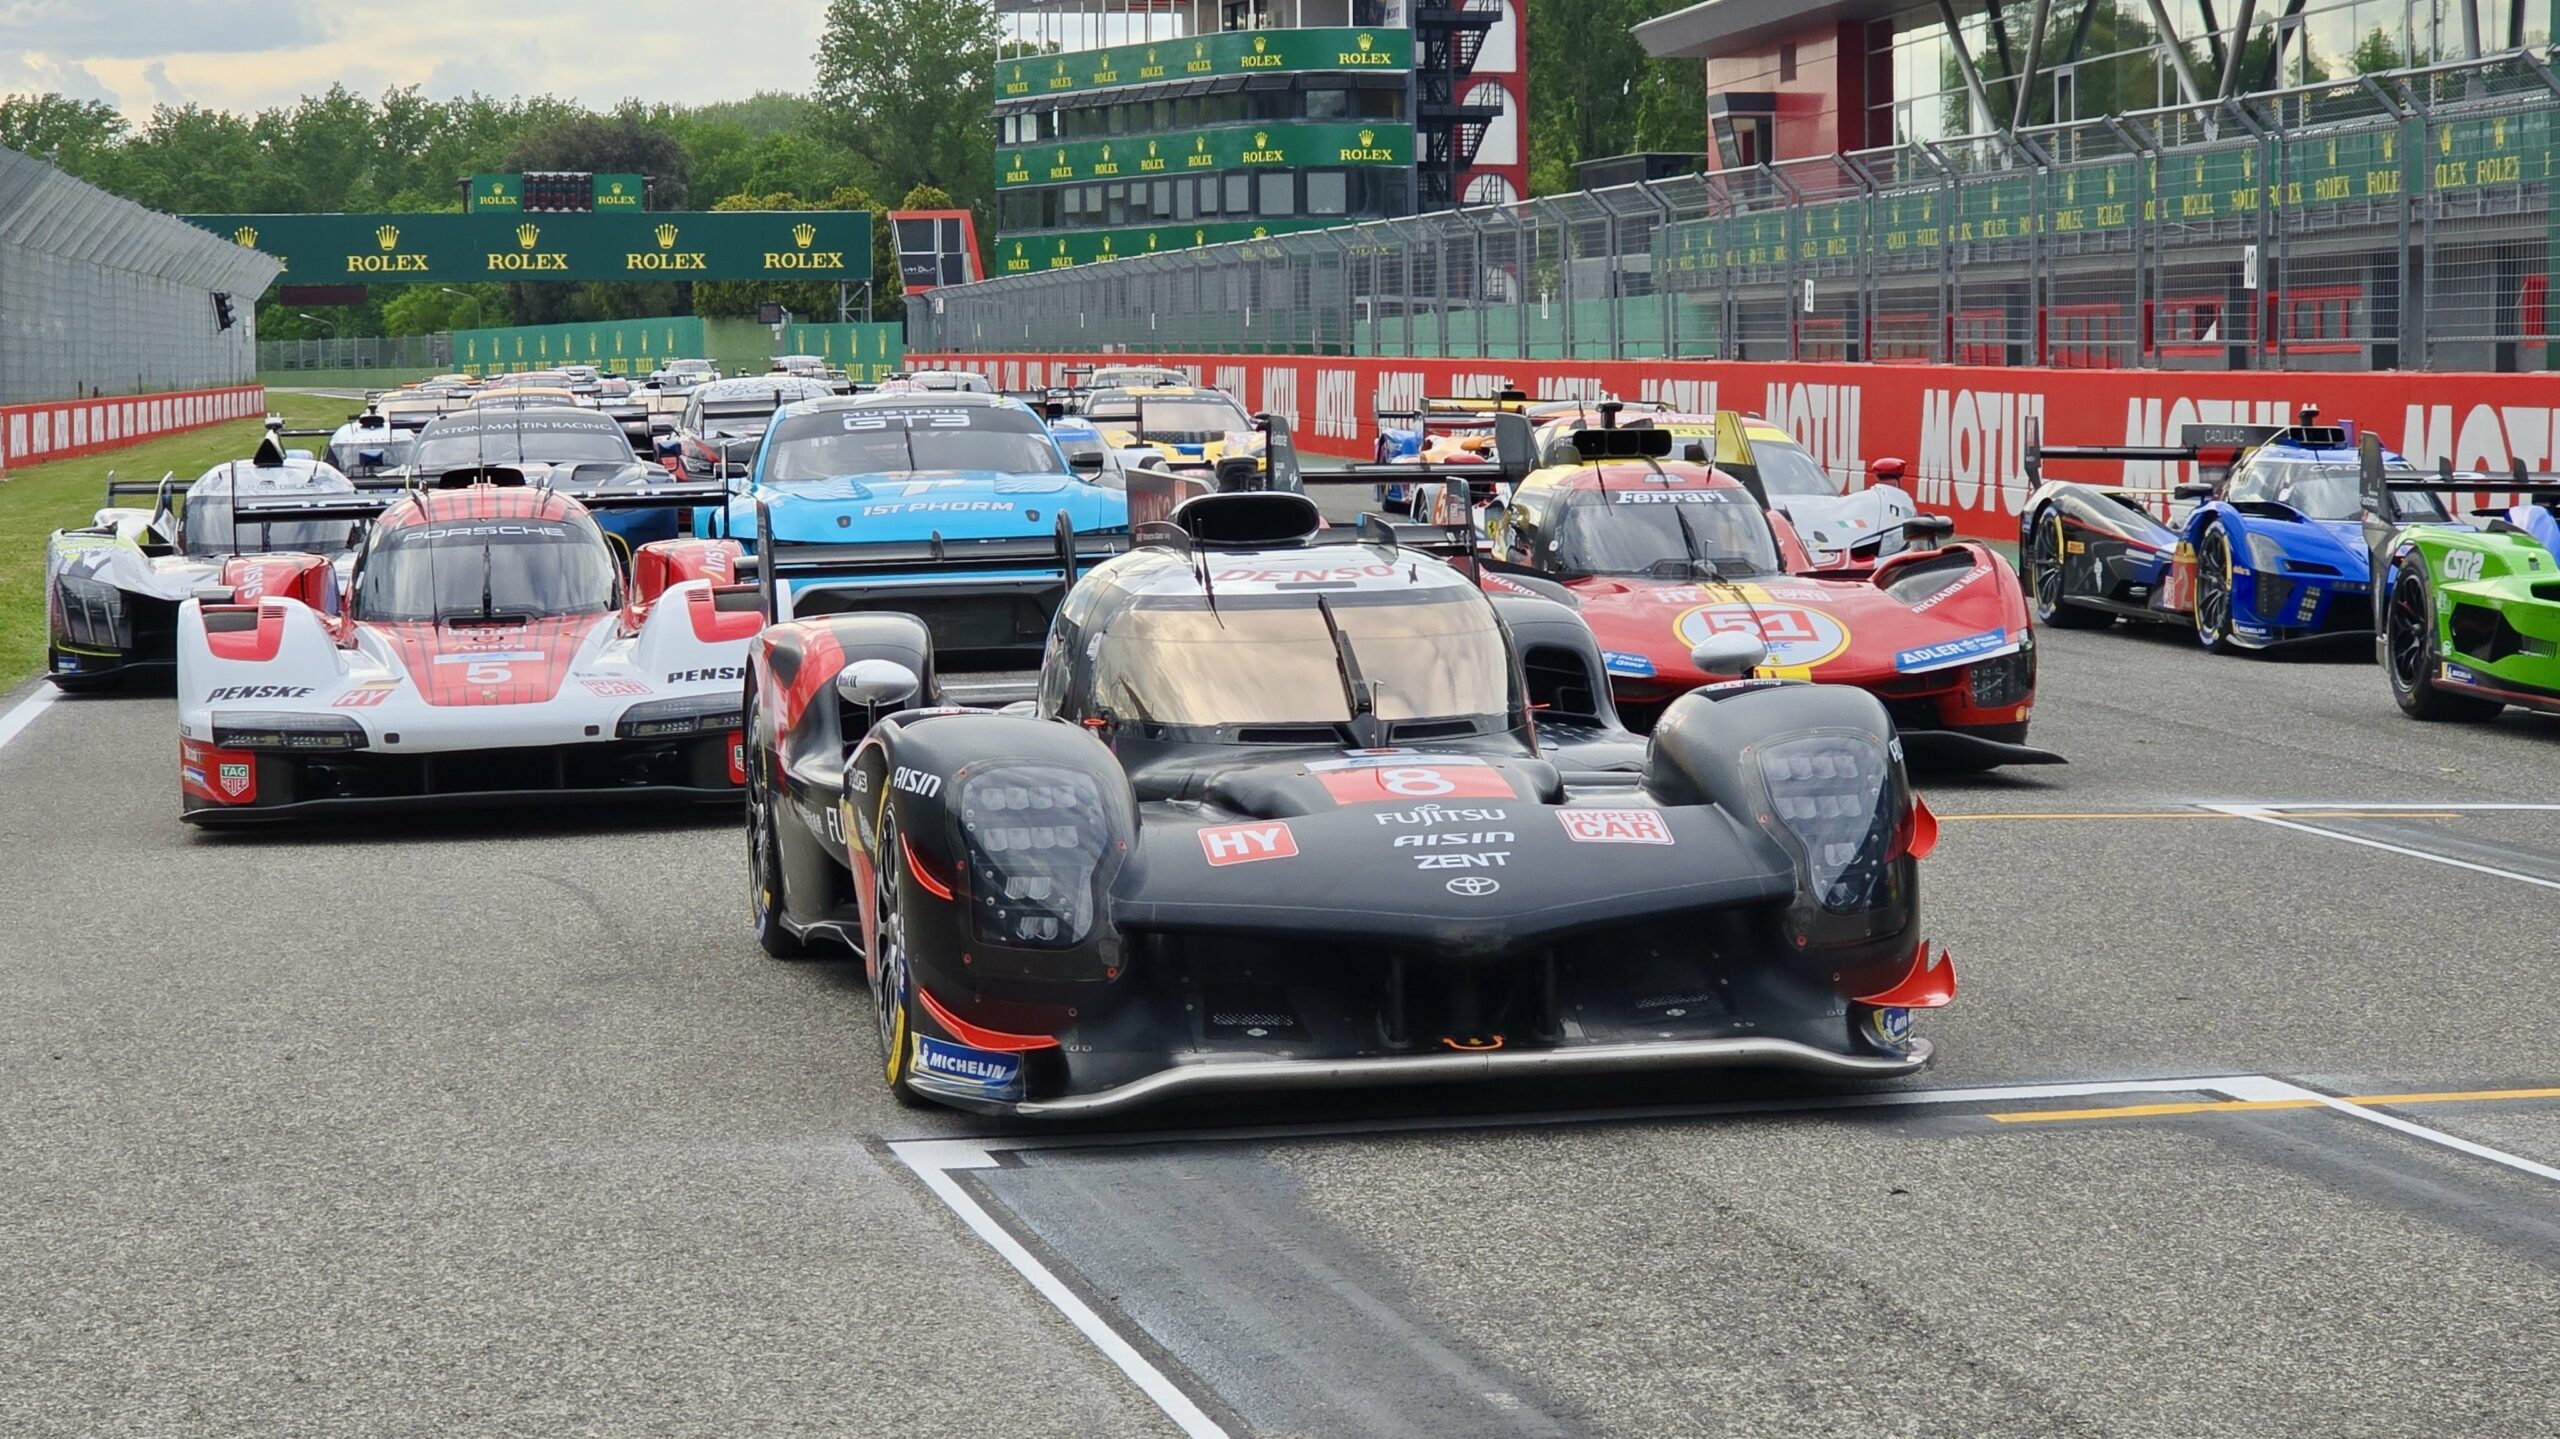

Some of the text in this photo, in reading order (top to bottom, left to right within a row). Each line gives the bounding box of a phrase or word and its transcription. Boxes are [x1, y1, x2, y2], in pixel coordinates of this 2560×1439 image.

[1094, 71, 1117, 83] ROLEX
[1140, 65, 1164, 79] ROLEX
[1187, 59, 1212, 73] ROLEX
[1241, 54, 1283, 67] ROLEX
[1338, 52, 1392, 65] ROLEX
[1095, 162, 1118, 175] ROLEX
[1141, 157, 1165, 171] ROLEX
[1188, 154, 1213, 168] ROLEX
[1242, 150, 1284, 163] ROLEX
[1340, 149, 1393, 161] ROLEX
[2434, 161, 2467, 189] OLEX
[2476, 155, 2521, 185] ROLEX
[2367, 170, 2401, 196] ROLE
[479, 196, 517, 205] ROLEX
[597, 195, 636, 205] ROLEX
[2230, 187, 2260, 212] ROLE
[347, 252, 845, 272] ROLEX ROLEX ROLEX ROLEX
[841, 408, 968, 418] MUSTANG
[1315, 368, 1358, 440] MOTUL
[430, 421, 613, 436] ASTON MARTIN RACING
[844, 414, 971, 431] GT3
[2204, 429, 2245, 443] CADILLAC
[1615, 489, 1730, 504] Ferrari
[862, 500, 1016, 517] 1ST PHORM
[402, 526, 567, 543] PORSCHE
[1213, 564, 1395, 582] DENSO
[2443, 548, 2485, 582] CSR2
[1655, 588, 1699, 603] HY
[1910, 563, 1994, 614] RICHARD MILLE
[1709, 611, 1813, 638] 51
[1901, 643, 1966, 665] ADLER
[466, 661, 512, 684] 5
[205, 685, 316, 704] PENSKE
[221, 766, 247, 777] TAG
[1382, 767, 1456, 796] 8
[221, 778, 249, 794] HEUER
[893, 765, 942, 799] AISIN
[1374, 803, 1507, 827] FUJITSU
[1565, 809, 1653, 824] HYPER
[1393, 830, 1515, 847] AISIN
[1574, 820, 1662, 841] CAR
[1207, 827, 1281, 859] HY
[1413, 851, 1511, 870] ZENT
[929, 1052, 1007, 1081] MICHELIN
